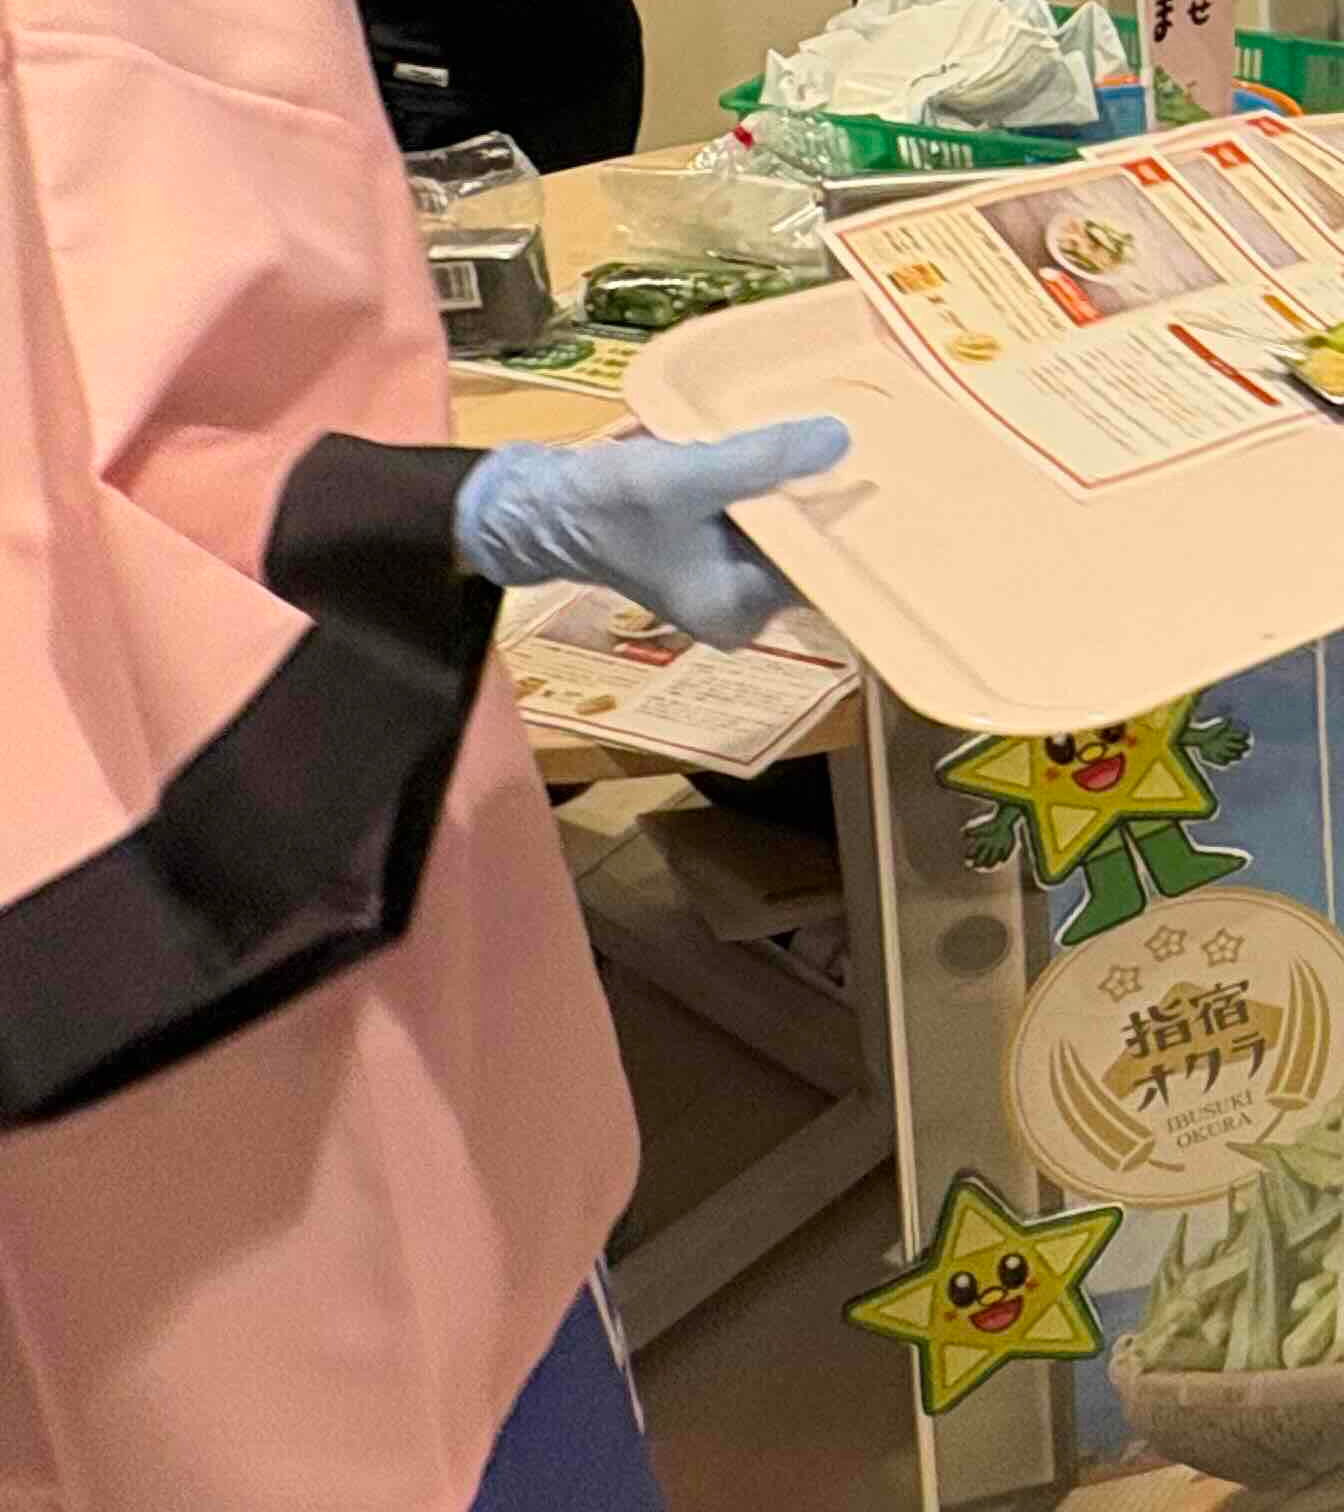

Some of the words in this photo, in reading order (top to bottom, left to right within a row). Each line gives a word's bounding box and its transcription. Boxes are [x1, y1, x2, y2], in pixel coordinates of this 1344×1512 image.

[1118, 978, 1251, 1060] 指宿
[1131, 1031, 1267, 1113] オクラ
[1167, 1088, 1254, 1136] IBUSUKI
[1175, 1111, 1253, 1149] OKURA
